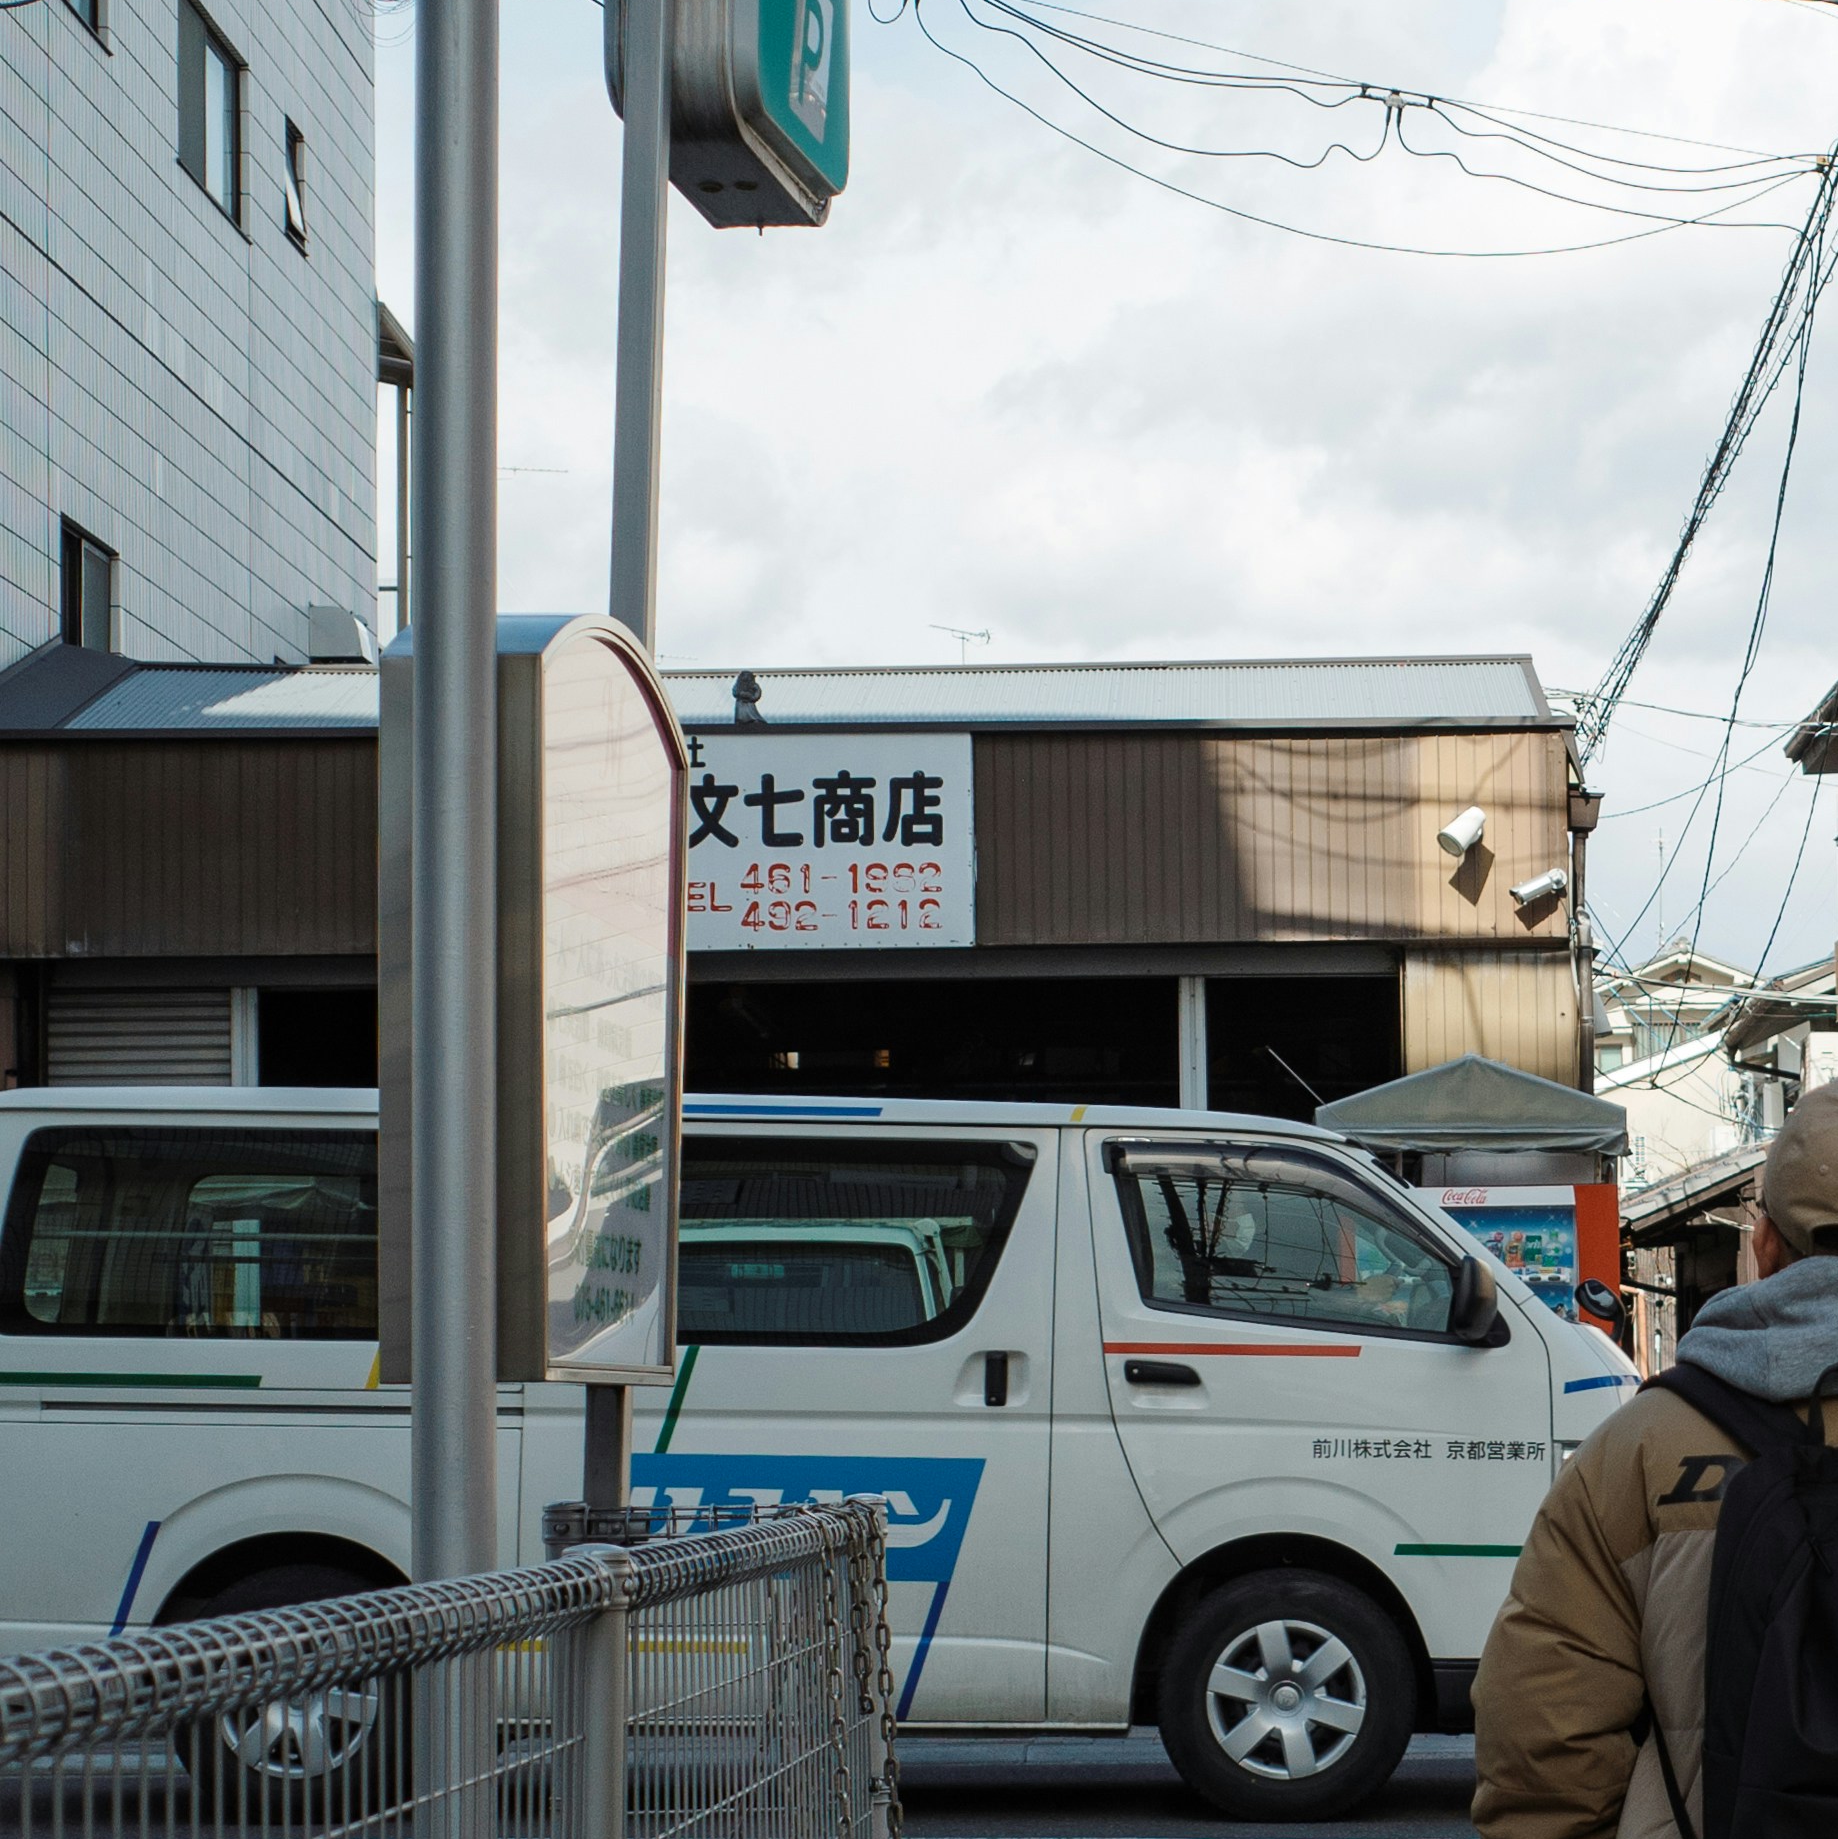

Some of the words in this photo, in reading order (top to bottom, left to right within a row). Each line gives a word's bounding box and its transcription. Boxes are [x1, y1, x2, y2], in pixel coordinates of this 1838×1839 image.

[689, 769, 944, 849] 文七商店
[687, 881, 733, 912] EL
[740, 898, 943, 932] 492-1212
[1312, 1438, 1432, 1459] 前川株式会社
[1446, 1440, 1546, 1461] 京都営業所
